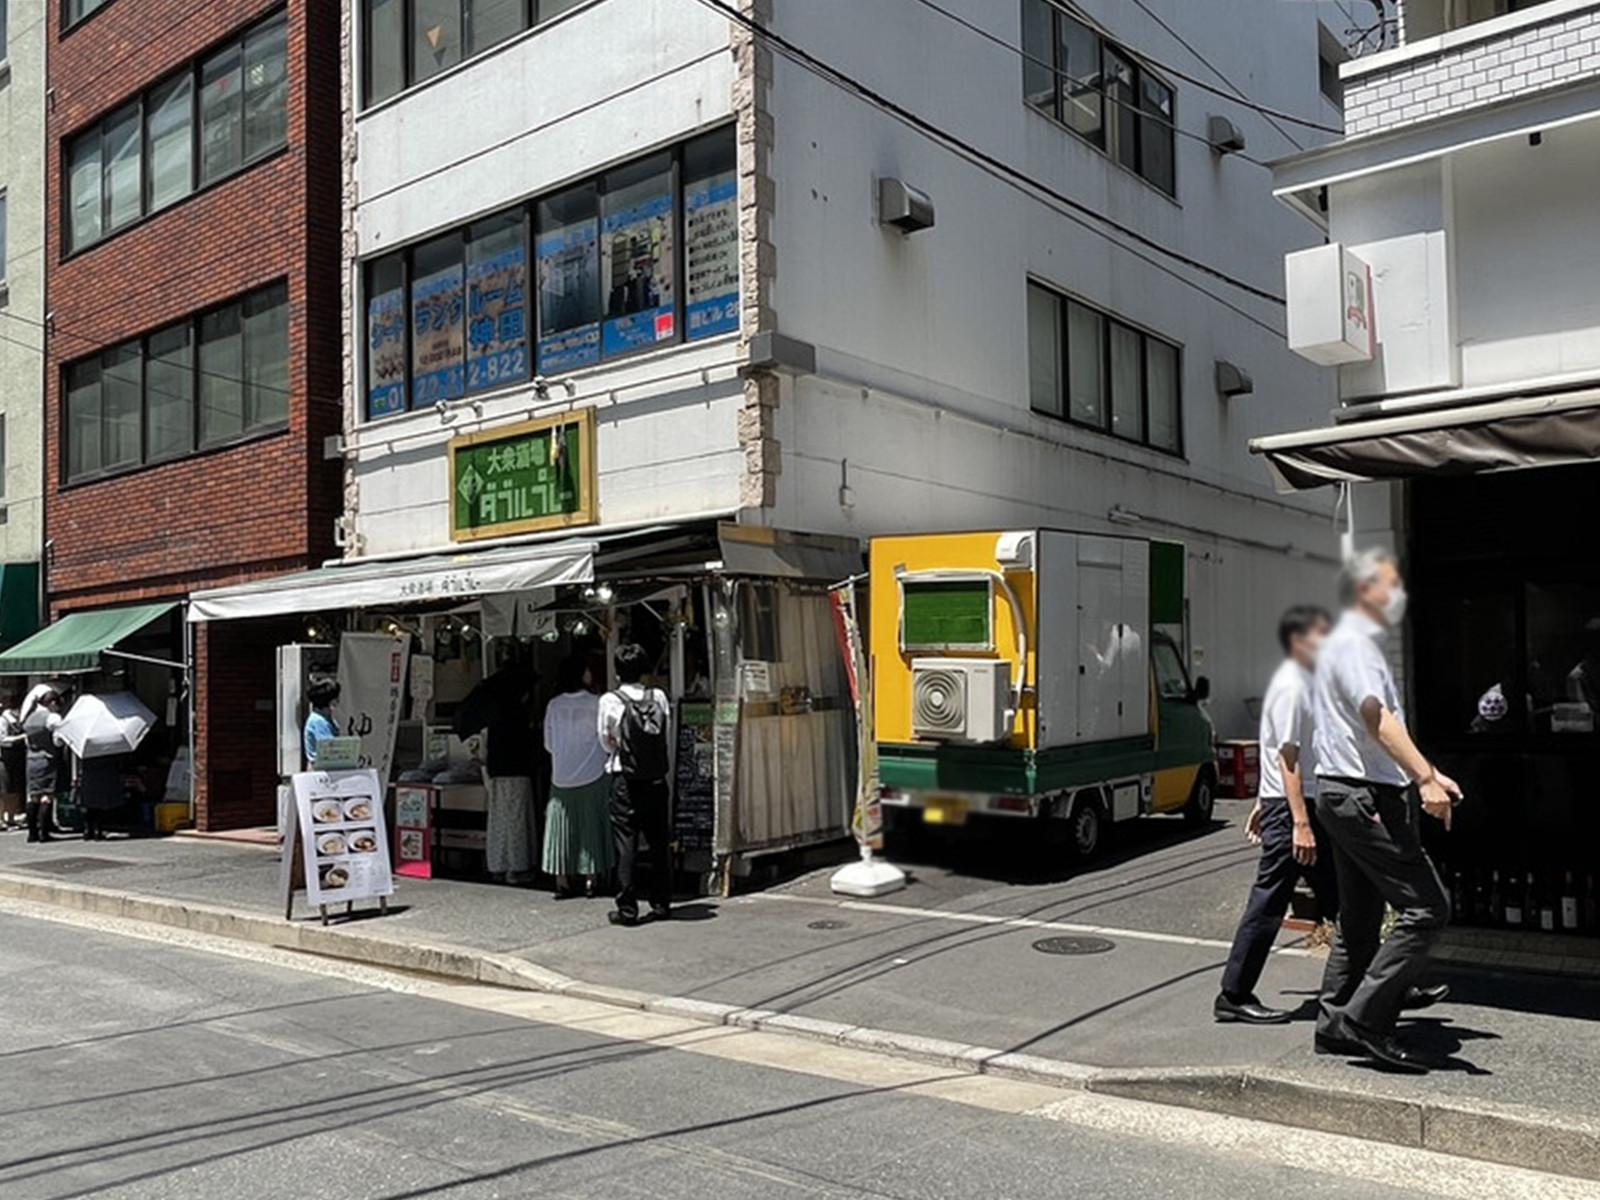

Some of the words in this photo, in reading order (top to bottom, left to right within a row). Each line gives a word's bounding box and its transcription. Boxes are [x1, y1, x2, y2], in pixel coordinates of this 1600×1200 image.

[469, 307, 525, 351] 神田
[480, 468, 573, 522] ダブルプレー
